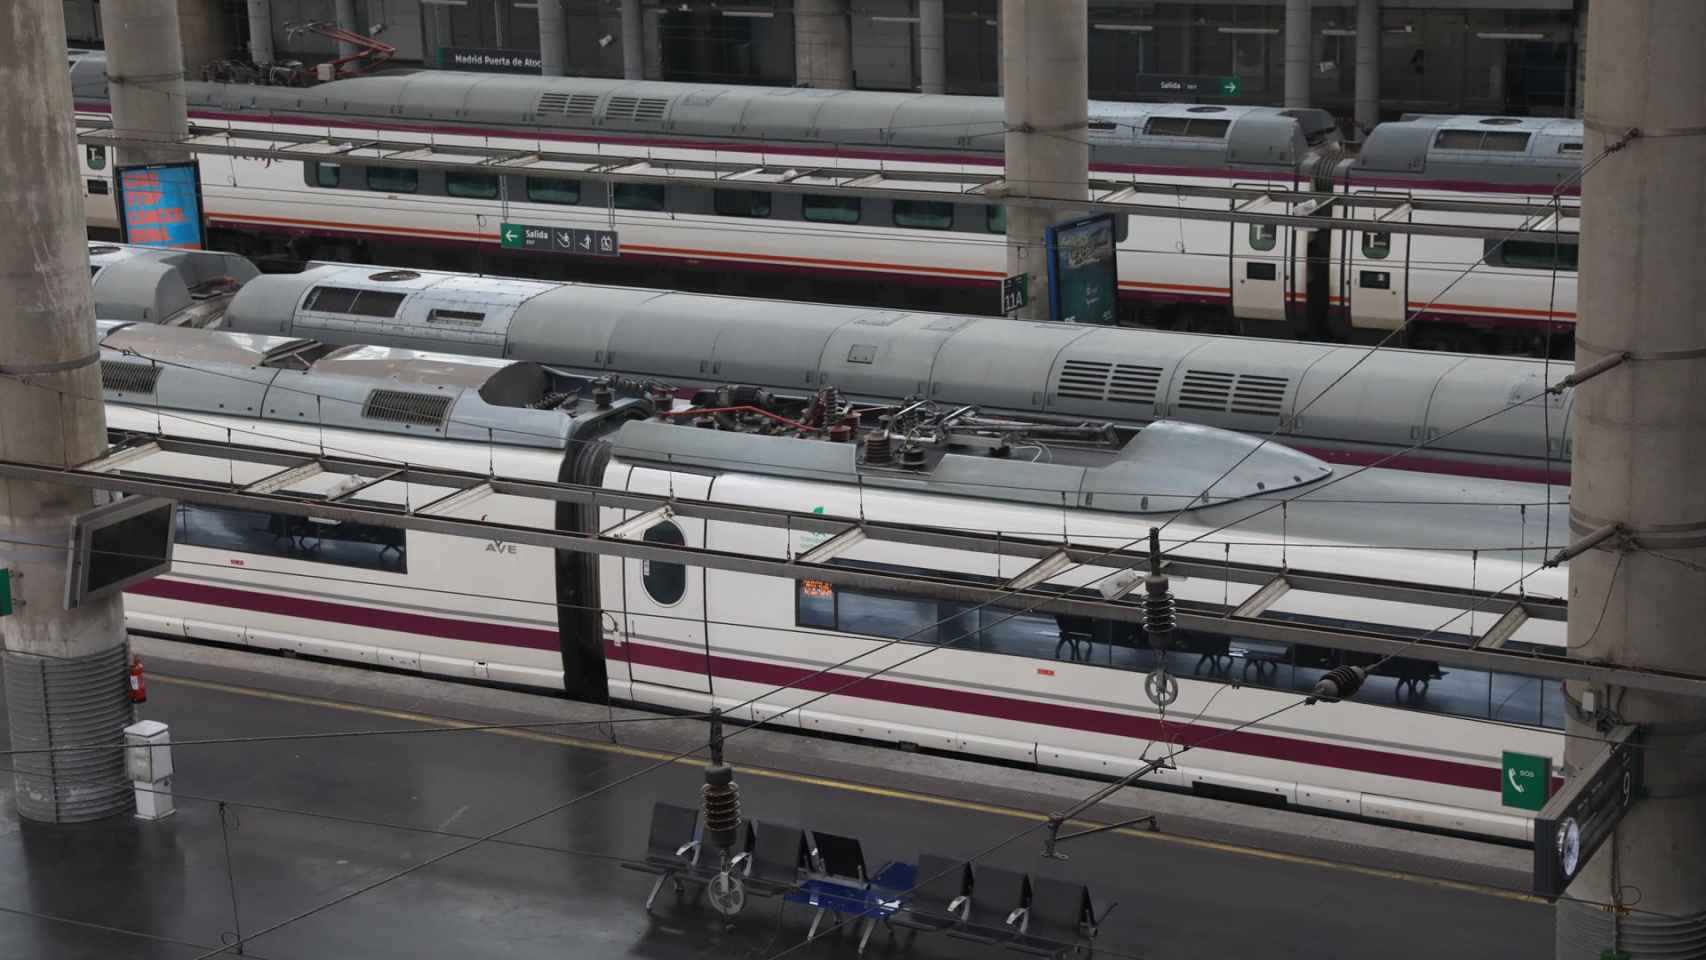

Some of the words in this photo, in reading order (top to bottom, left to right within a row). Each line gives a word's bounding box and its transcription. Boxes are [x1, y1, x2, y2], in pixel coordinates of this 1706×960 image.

[455, 54, 483, 65] Madrid
[484, 56, 511, 66] Puerta
[512, 57, 523, 67] de
[525, 229, 549, 239] Salida
[1005, 290, 1024, 310] 11A
[485, 543, 517, 554] AVE
[1519, 769, 1536, 778] SOS
[1623, 771, 1631, 807] 9
